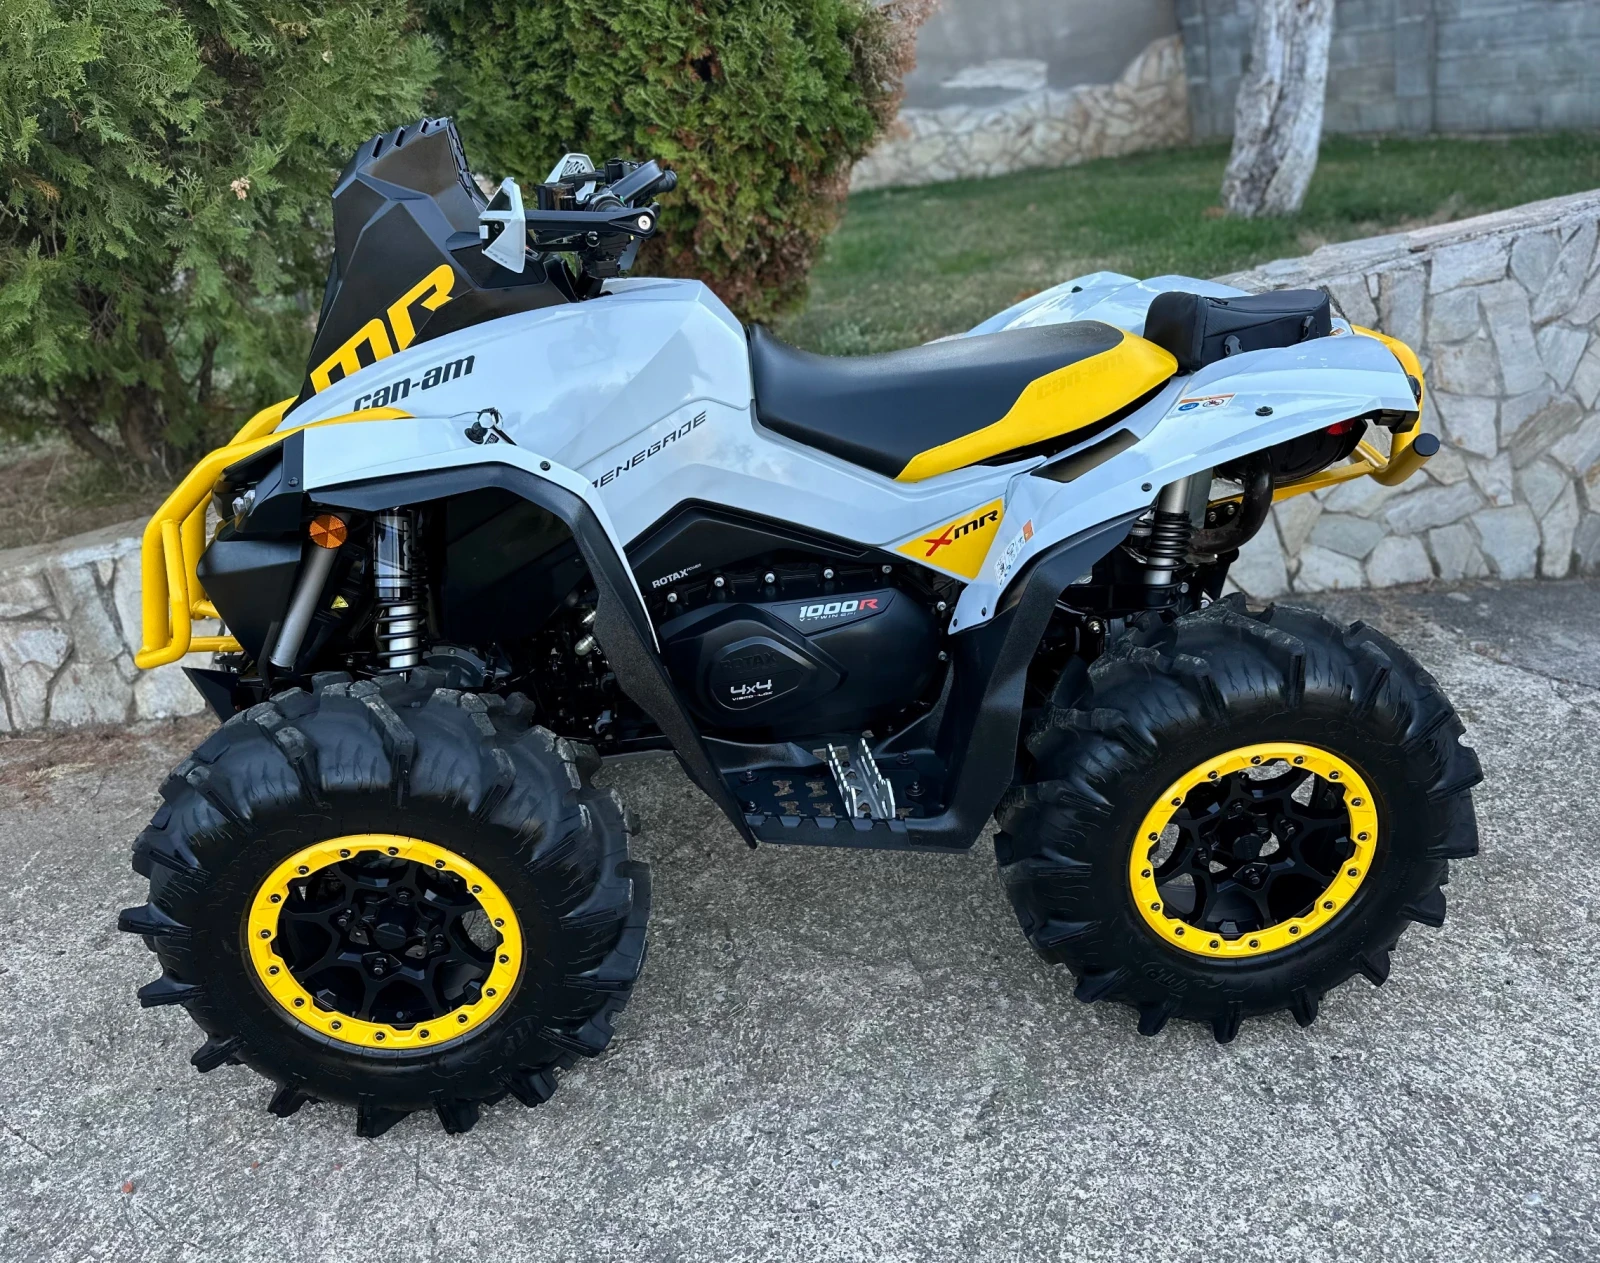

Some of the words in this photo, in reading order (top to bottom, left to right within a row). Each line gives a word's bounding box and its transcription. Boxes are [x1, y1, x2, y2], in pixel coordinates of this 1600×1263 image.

[353, 355, 475, 412] can-am
[1035, 354, 1124, 400] can-am
[652, 568, 688, 588] ROTAX
[799, 598, 878, 619] 1000R
[799, 614, 838, 622] V-TWIN
[730, 679, 772, 695] 4x4
